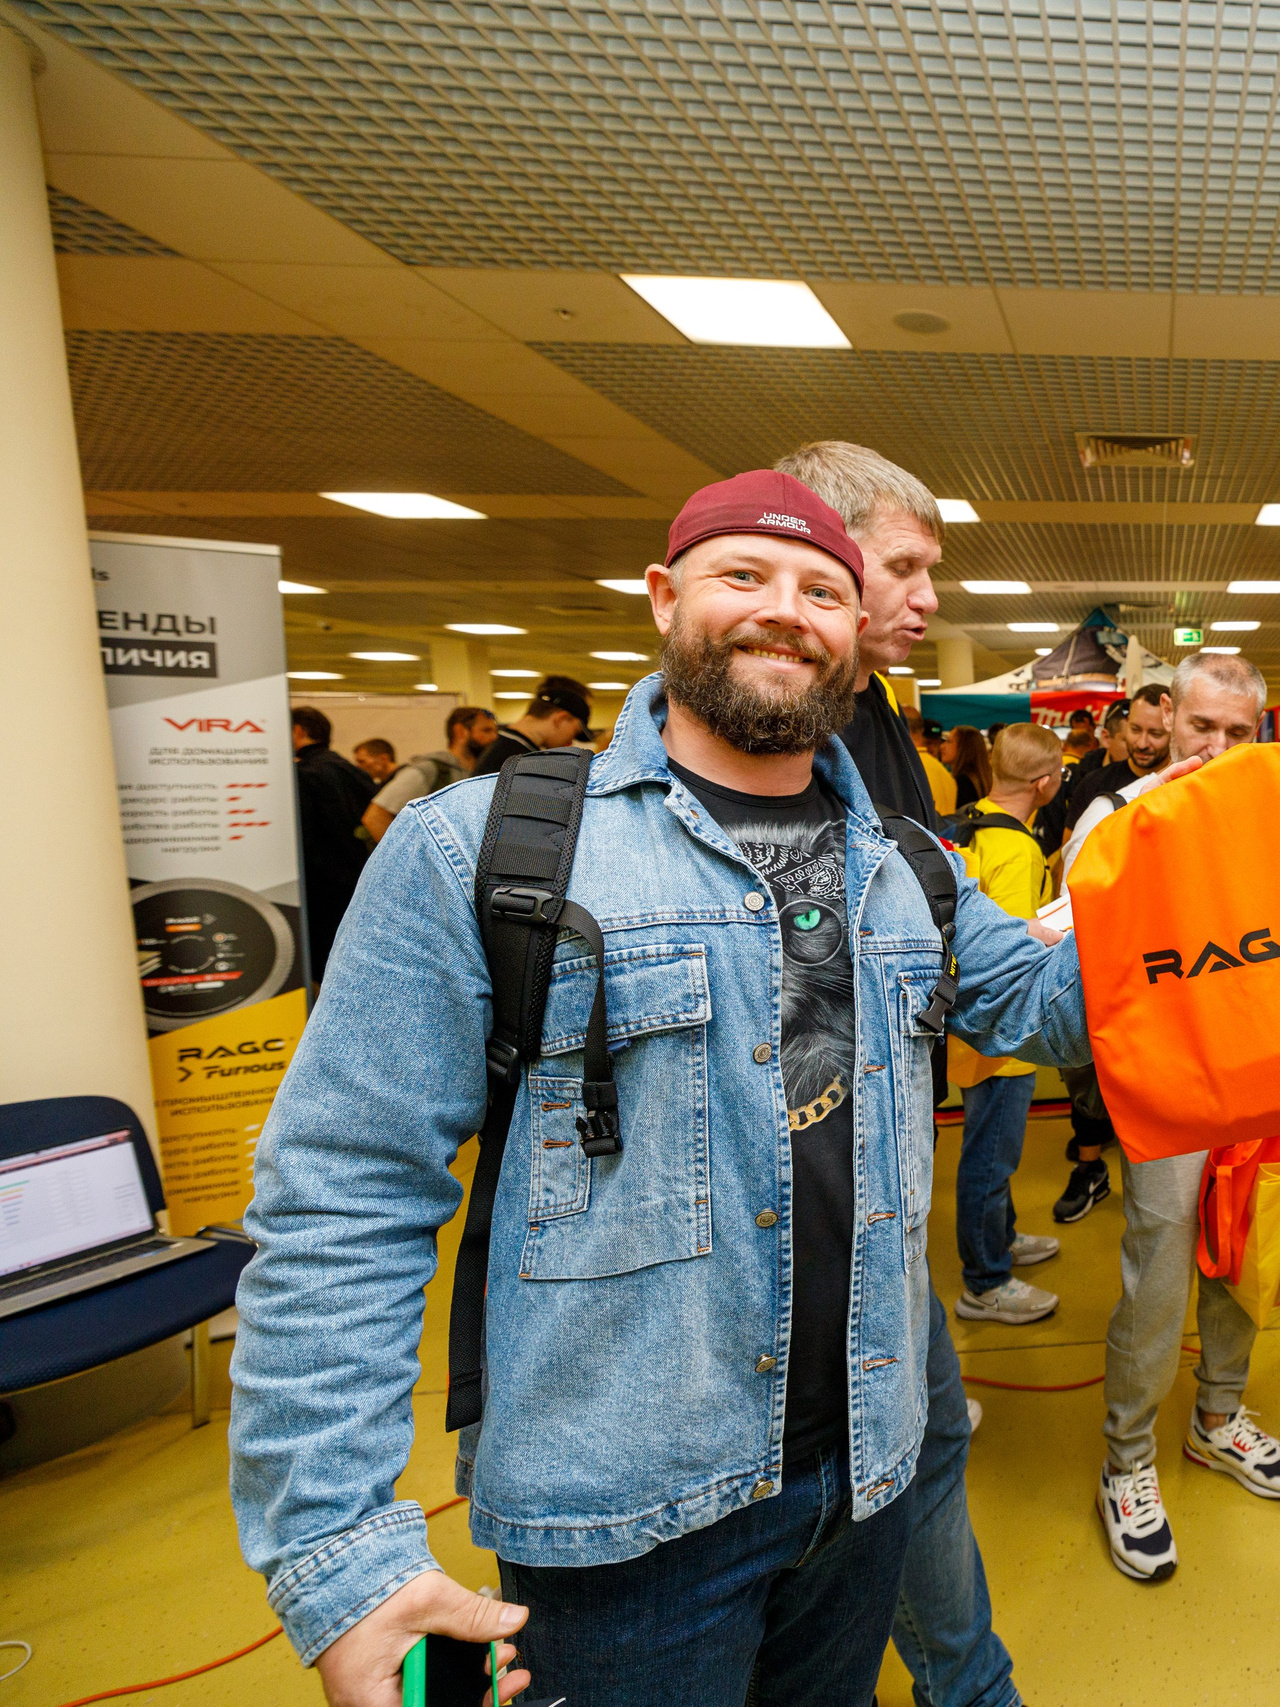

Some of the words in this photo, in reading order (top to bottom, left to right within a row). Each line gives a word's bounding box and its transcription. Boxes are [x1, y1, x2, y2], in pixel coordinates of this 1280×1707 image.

[756, 517, 812, 535] ARMOUR
[763, 512, 807, 527] UNDER
[161, 717, 265, 733] VIRA
